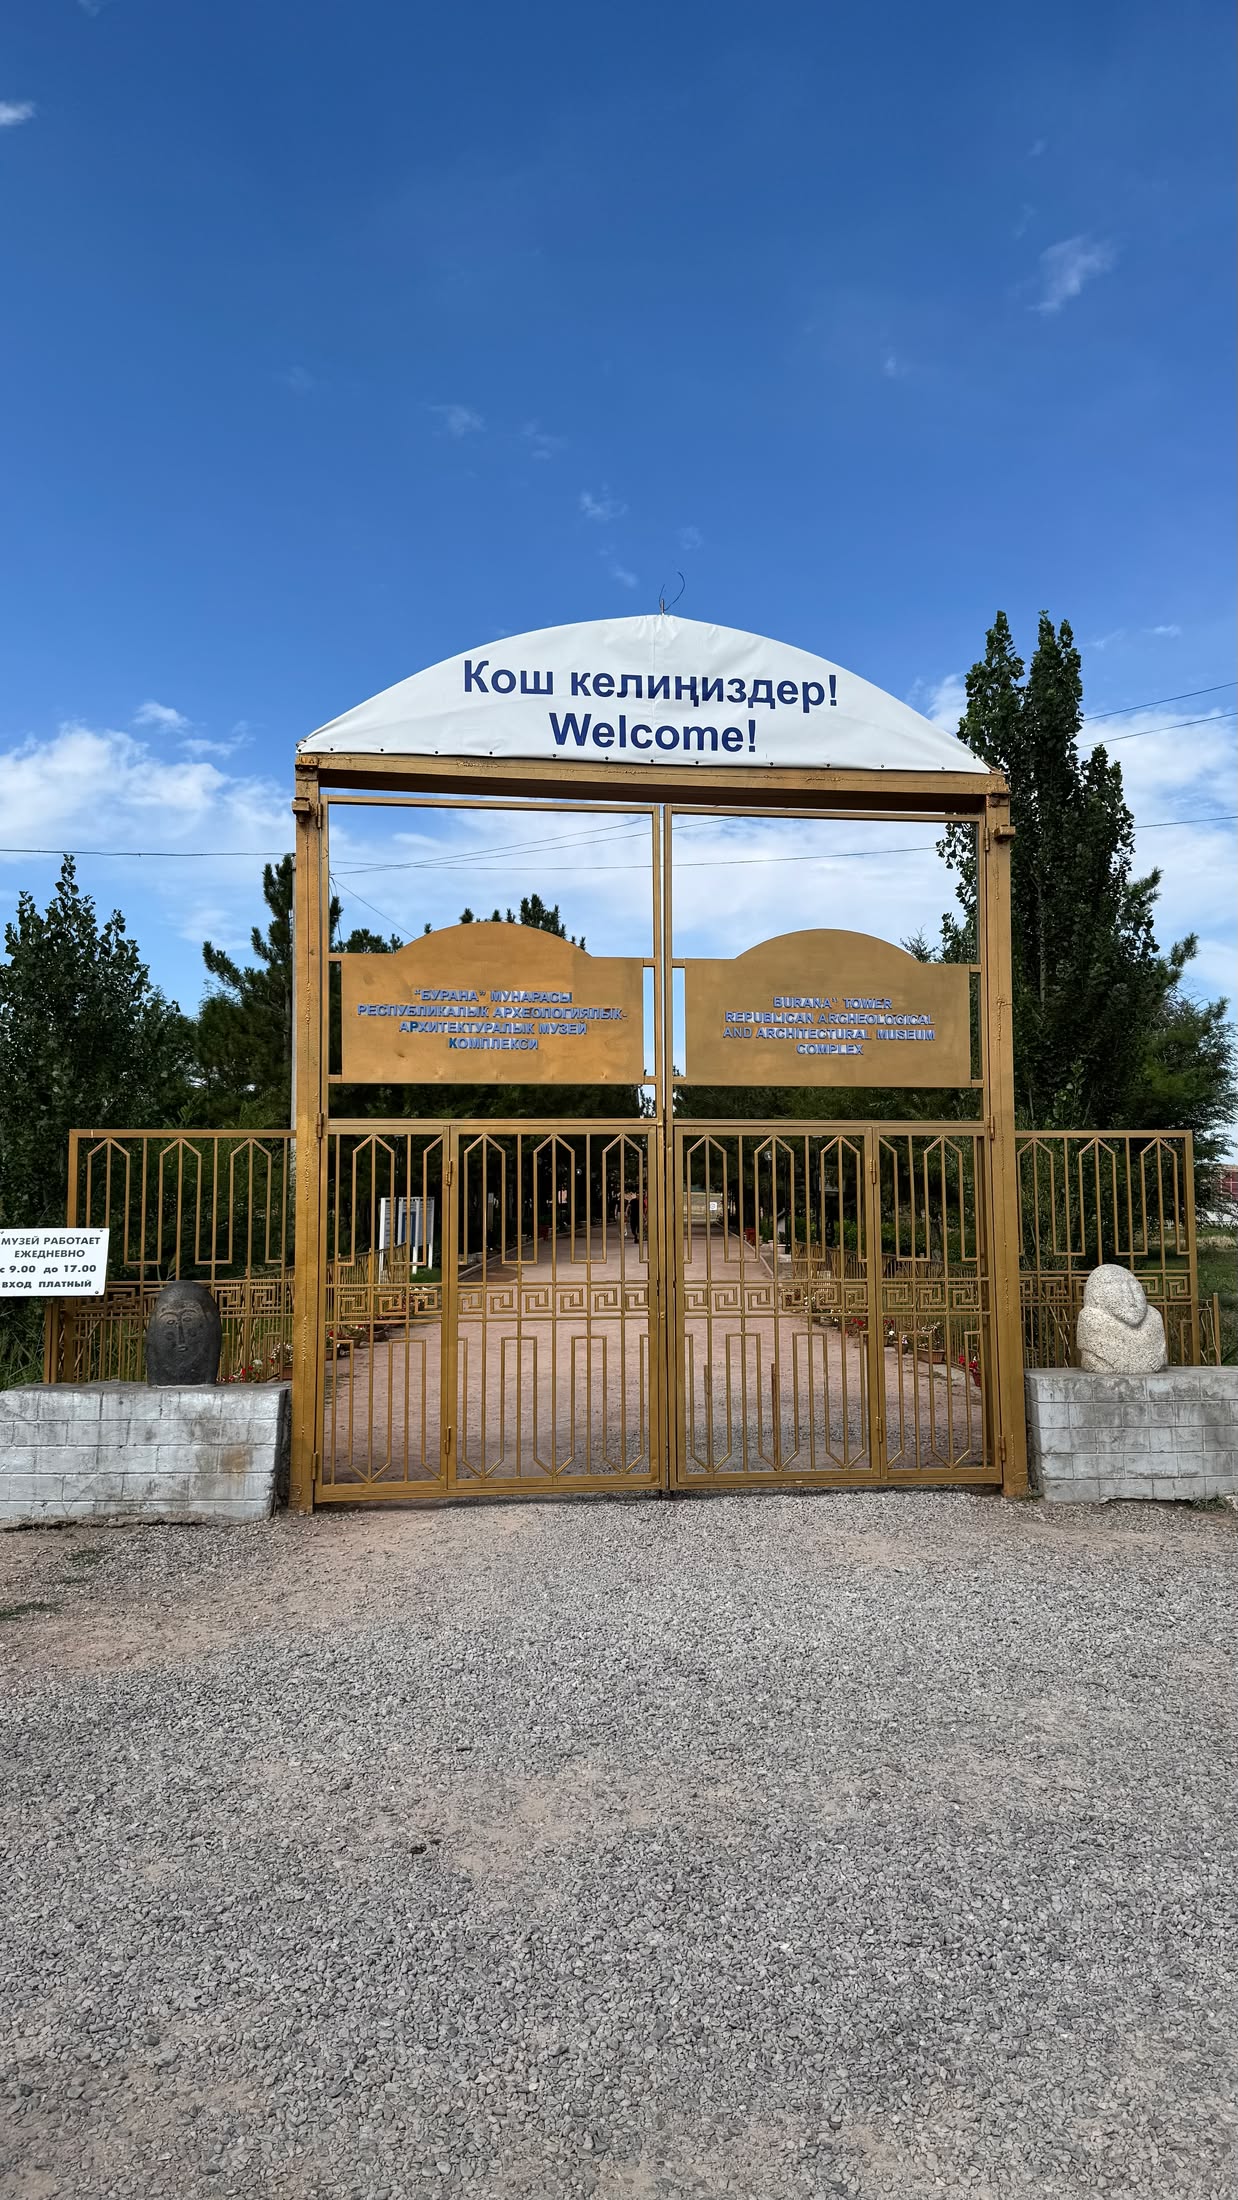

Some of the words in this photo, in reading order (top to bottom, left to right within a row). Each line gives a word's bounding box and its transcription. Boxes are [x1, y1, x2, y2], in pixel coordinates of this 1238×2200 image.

[464, 659, 554, 695] Кош
[570, 671, 838, 714] келиңиздер!
[548, 712, 757, 753] Welcome!
[490, 990, 573, 1003] МУНАРАСЫ
[843, 998, 893, 1010] TOWER
[356, 1004, 489, 1018] РЕСПУБЛИКАЛЫК
[725, 1011, 815, 1024] REPUBLICAN
[817, 1013, 935, 1026] ARCHEOLOGICAL
[398, 1021, 535, 1035] АРХИТЕКТУРАЛЫК
[538, 1021, 588, 1035] МУЗЕЙ
[723, 1026, 753, 1039] AND
[756, 1027, 872, 1040] ARCHITECTURAL
[875, 1029, 936, 1041] MUSEUM
[448, 1037, 539, 1050] КОМПЛЕКСИ
[796, 1043, 864, 1055] COMPLEX
[1, 1235, 40, 1246] МУЗЕЙ
[43, 1236, 101, 1245] РАБОТАЕТ
[14, 1249, 86, 1259] ЕЖЕДНЕВНО
[9, 1265, 36, 1273] 9.00
[63, 1264, 97, 1273] 17.00
